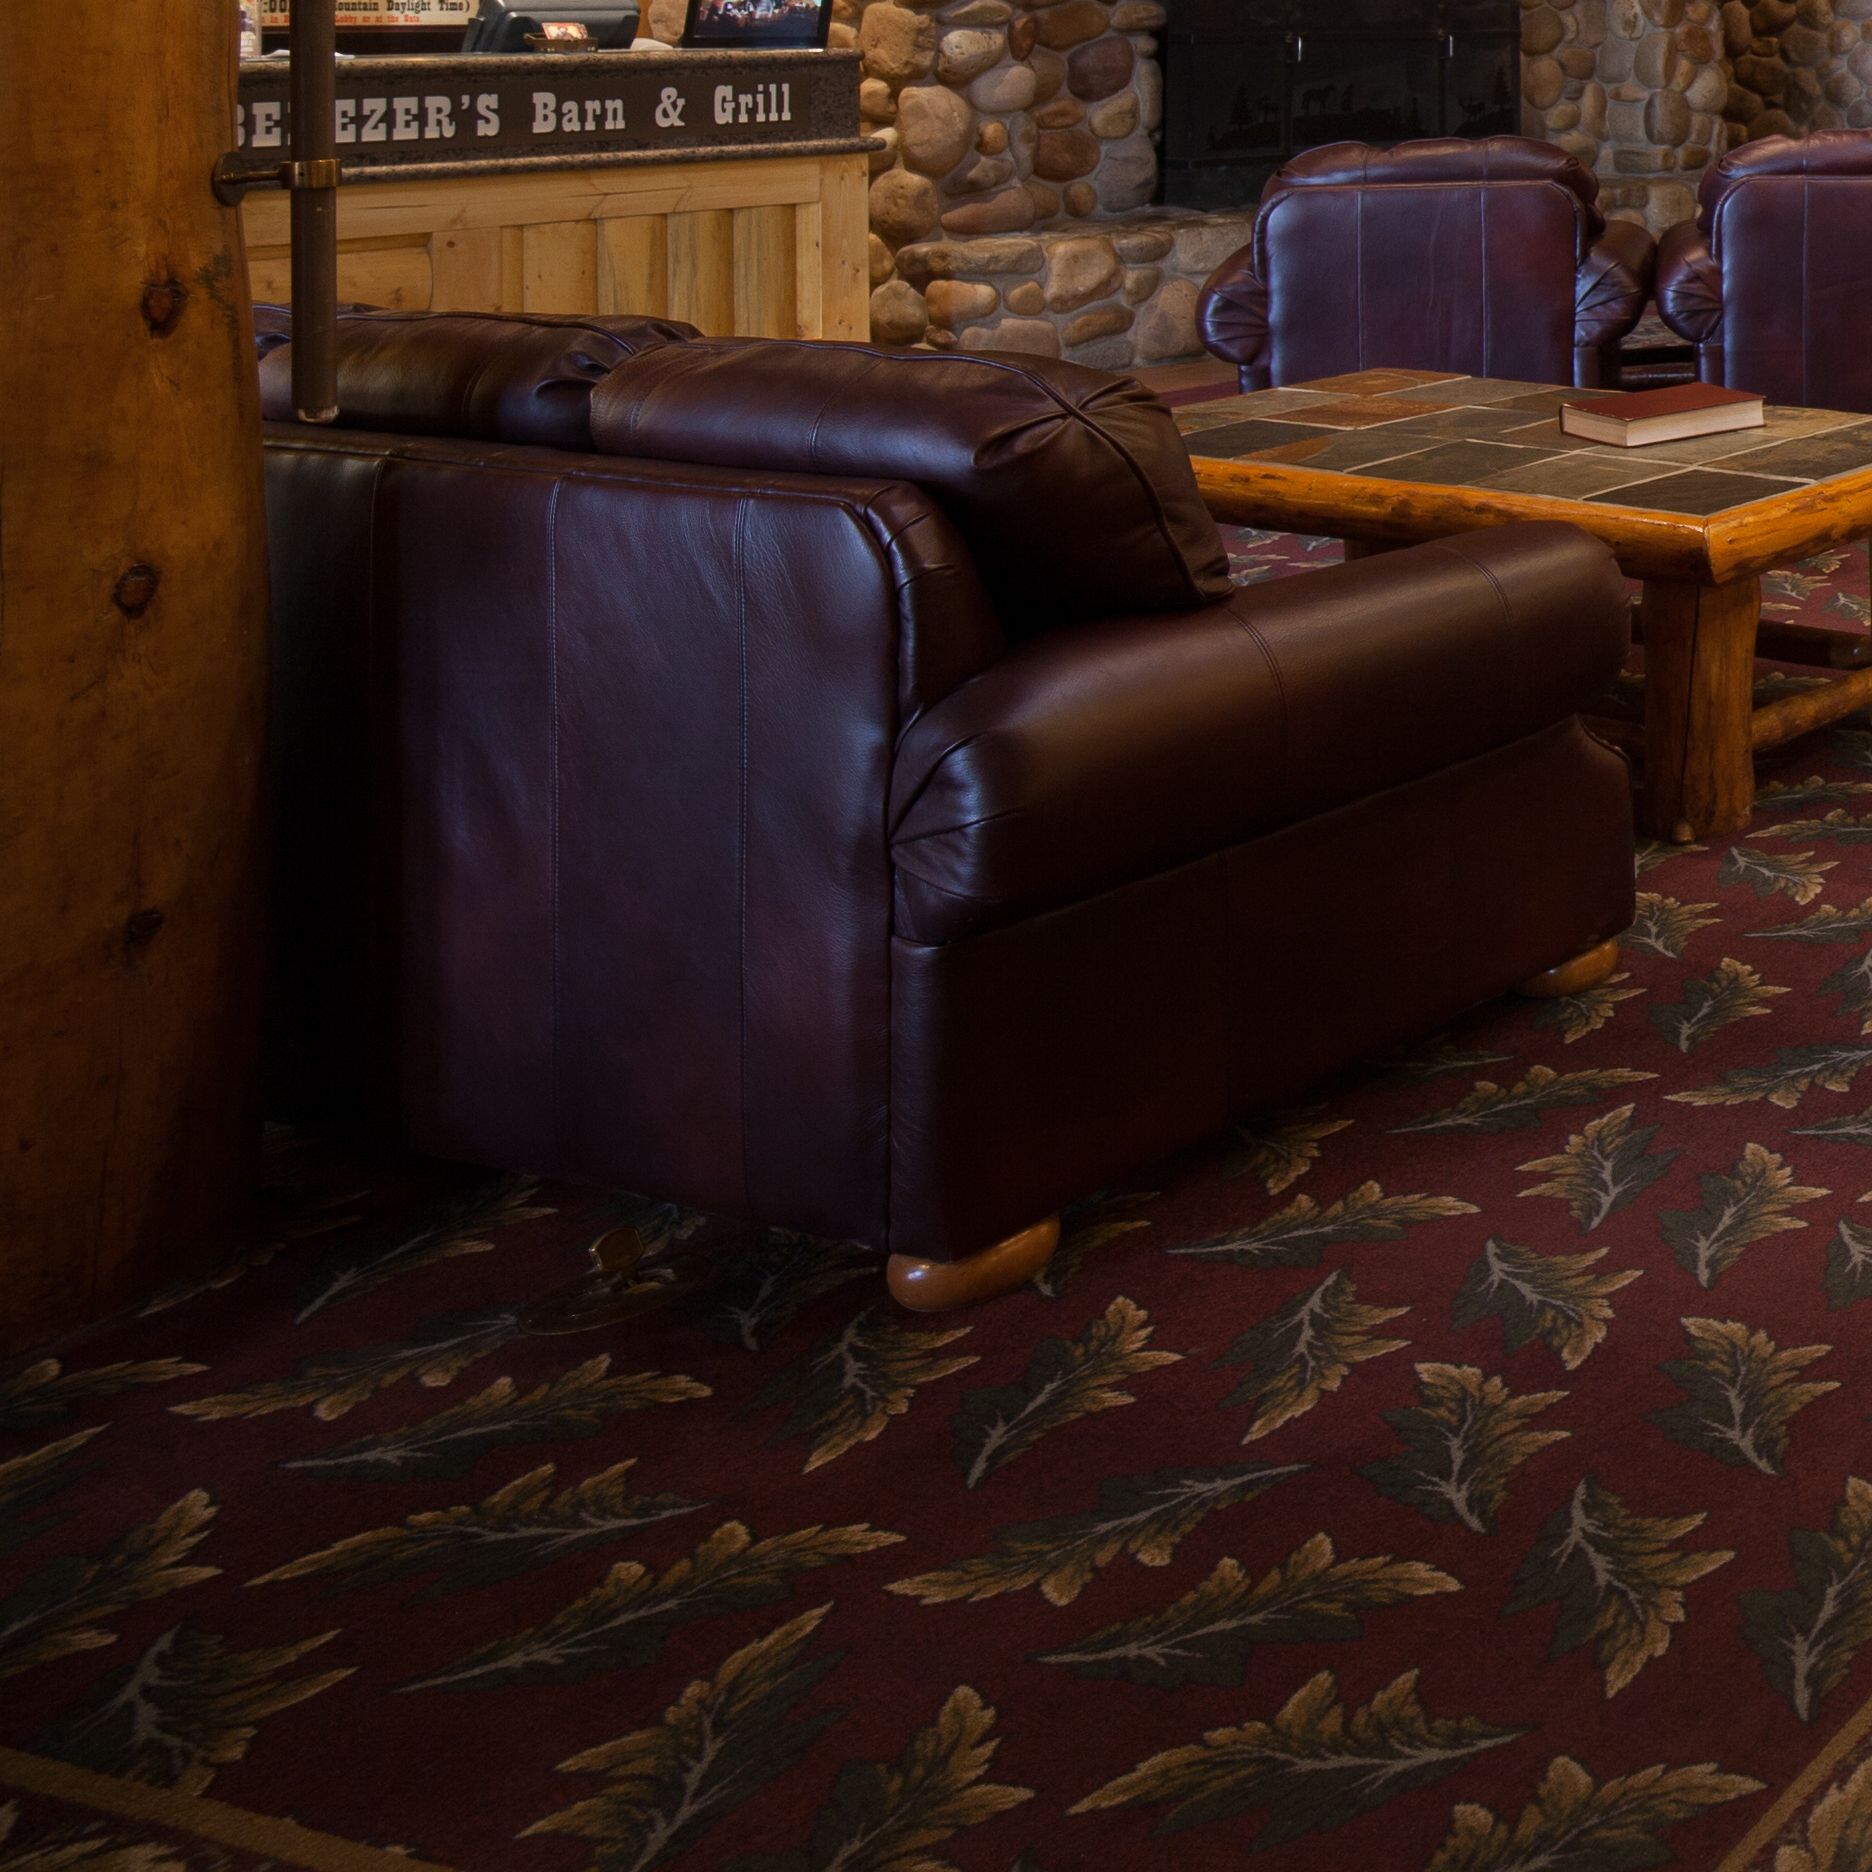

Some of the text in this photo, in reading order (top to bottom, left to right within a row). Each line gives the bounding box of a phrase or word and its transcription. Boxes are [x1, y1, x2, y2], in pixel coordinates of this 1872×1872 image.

[438, 0, 471, 14] Time)
[532, 91, 626, 134] Barn
[654, 86, 686, 128] &
[713, 83, 792, 125] Grill
